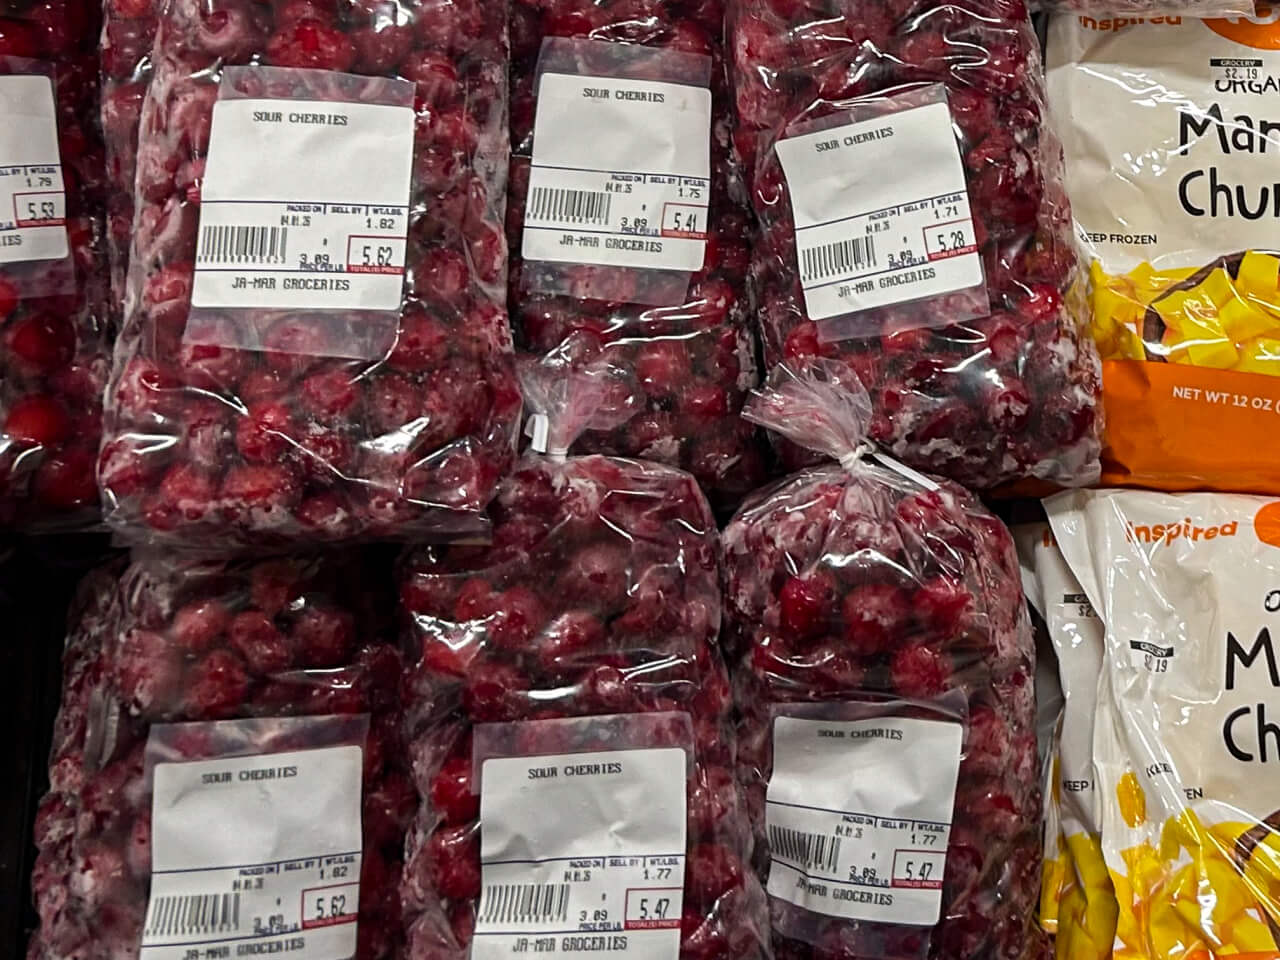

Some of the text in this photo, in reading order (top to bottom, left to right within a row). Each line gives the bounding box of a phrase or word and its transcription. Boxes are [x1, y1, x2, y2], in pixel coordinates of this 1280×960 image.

[1224, 66, 1257, 79] $2.19
[582, 87, 664, 102] SOUR CHERRIES
[253, 111, 348, 126] SOUR CHERRIES
[815, 127, 894, 152] SOUR CHERRIES
[674, 212, 697, 231] 5.41
[559, 235, 662, 253] JA-MAR GROCERIES
[937, 231, 965, 252] 5.28
[1110, 233, 1157, 246] FROZEN
[362, 246, 392, 266] 5.62
[231, 277, 350, 290] JA-MAR GROCERIES
[838, 267, 935, 297] JA-MAR GROCERIES
[1172, 386, 1201, 402] NET
[1204, 390, 1230, 405] WT
[1232, 394, 1248, 407] 12
[1250, 396, 1272, 411] OZ
[817, 729, 903, 741] SOUR CHERRIES
[202, 766, 297, 785] SOUR CHERRIES
[528, 762, 622, 779] SOUR CHERRIES
[315, 893, 345, 916] 5.62
[832, 886, 893, 905] GROCERIES
[182, 936, 305, 960] JA-MAR GROCERIES
[512, 934, 627, 952] JA-MAR GROCERIES
